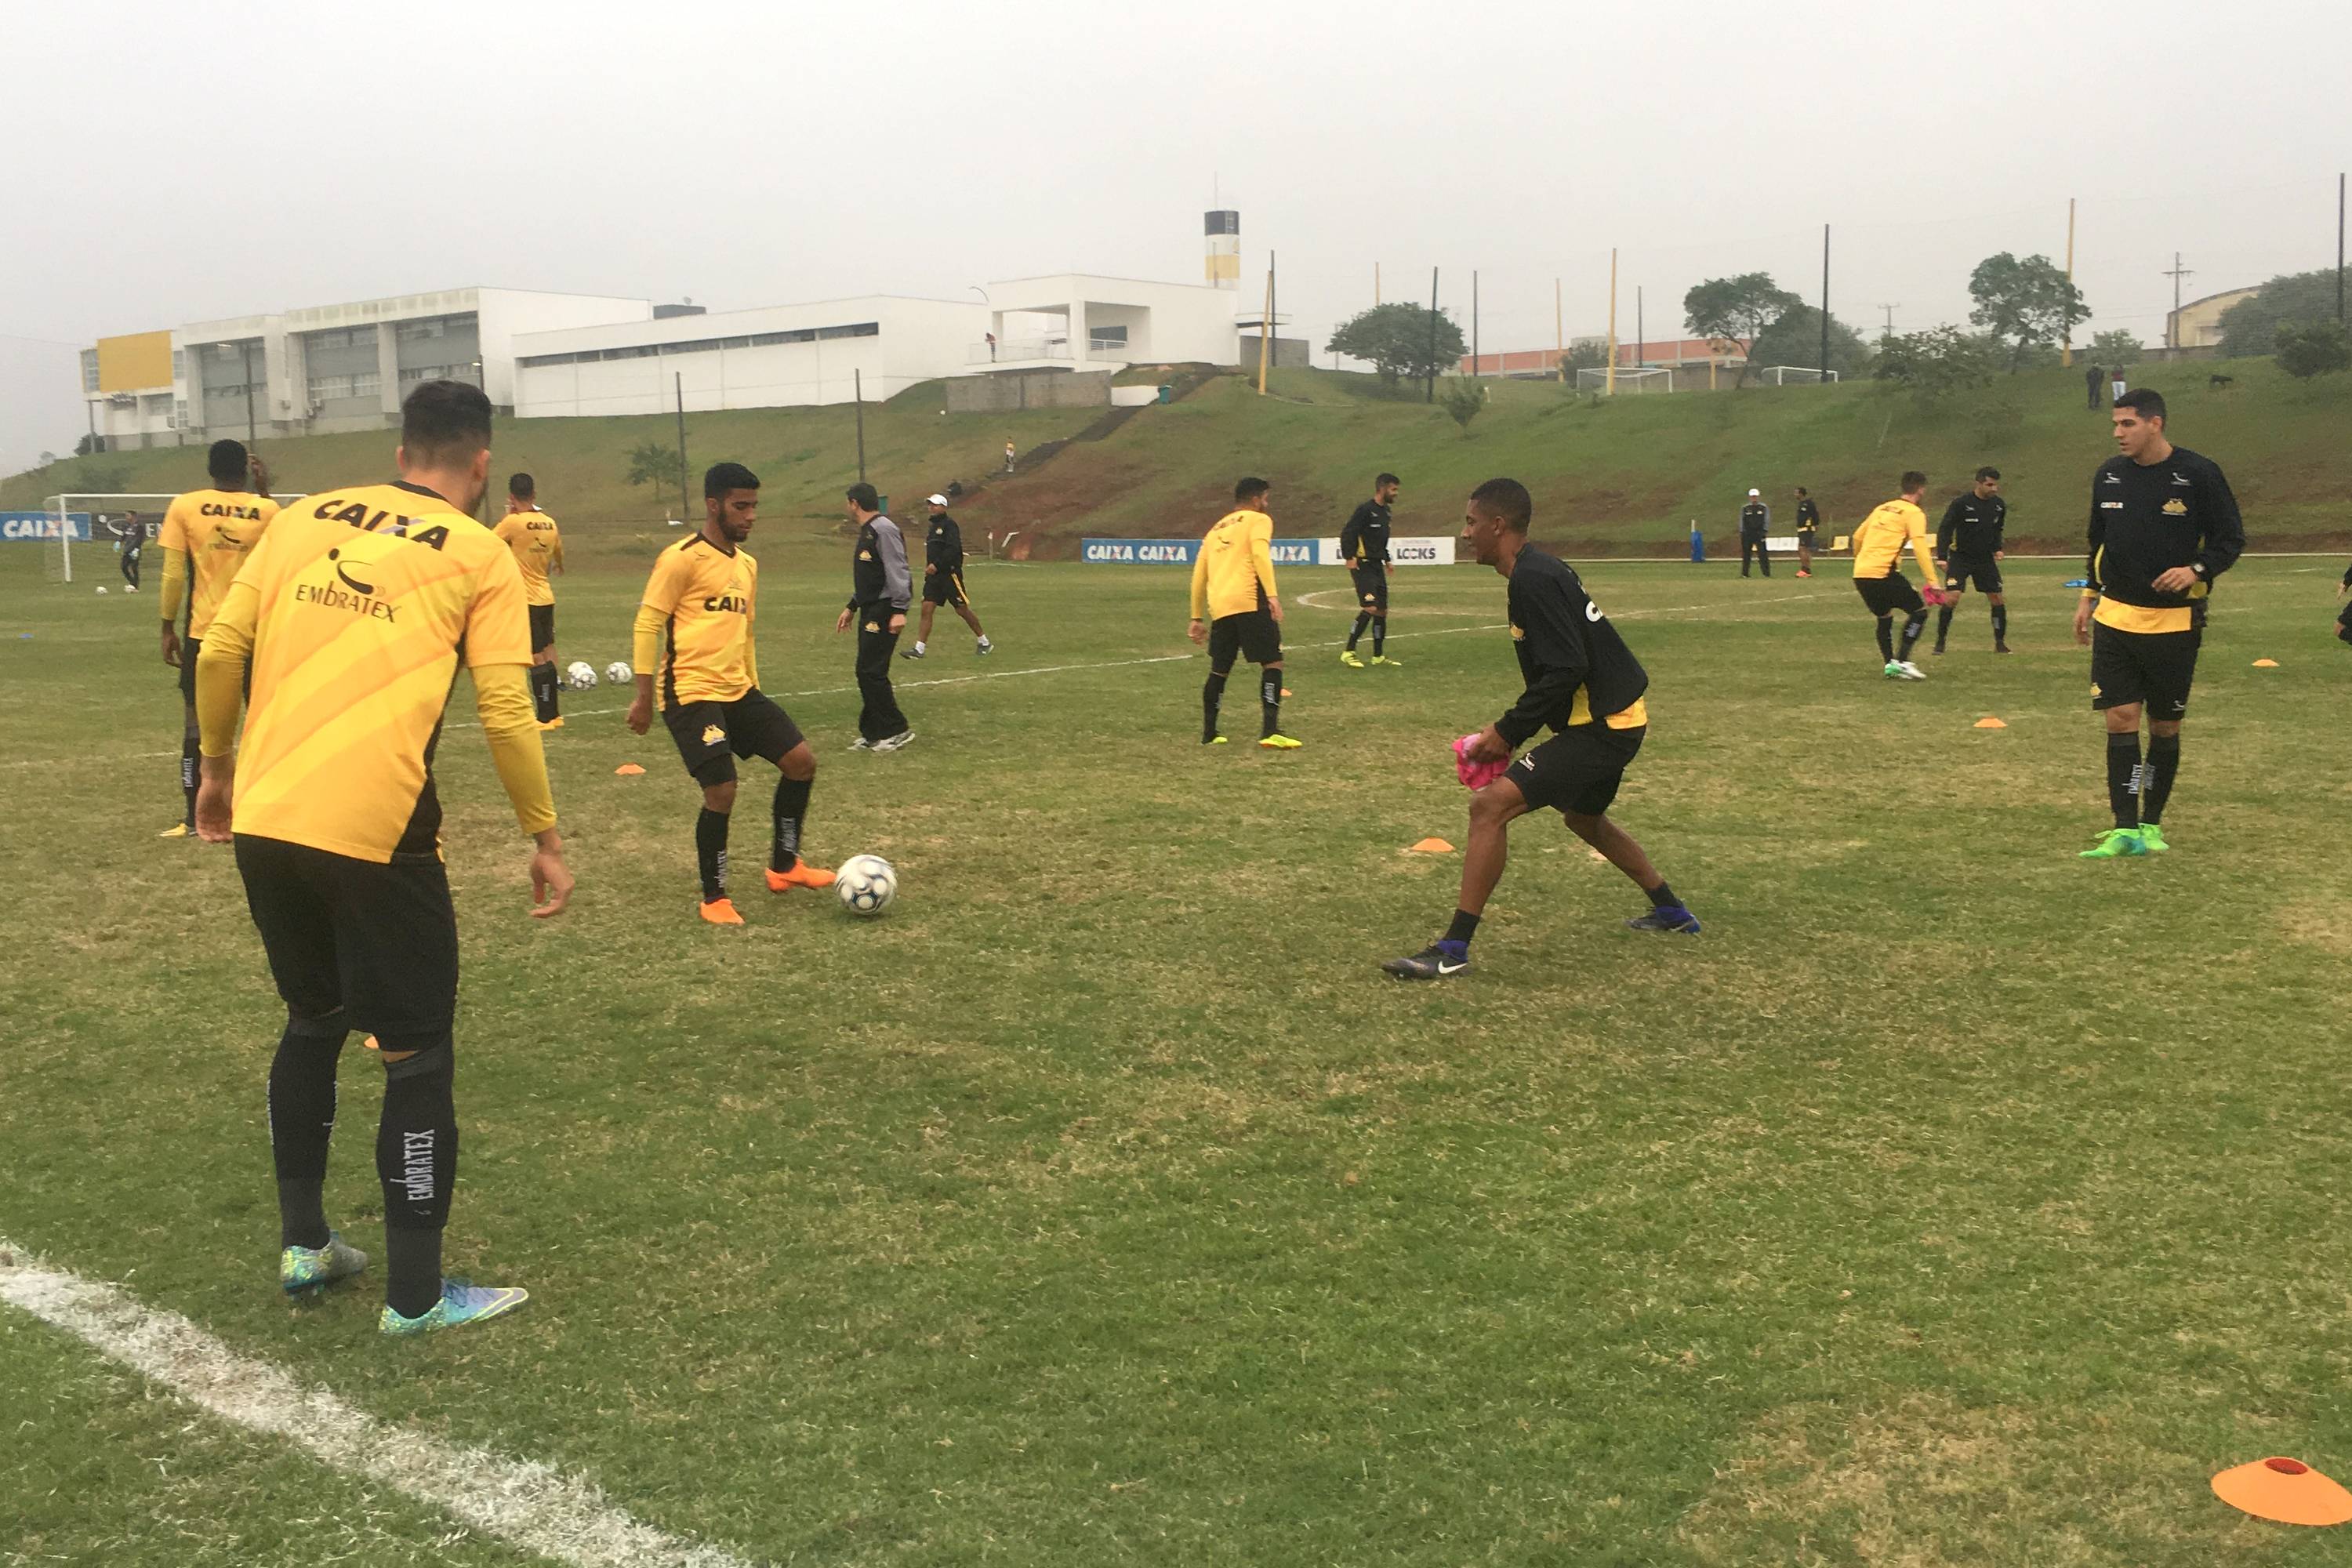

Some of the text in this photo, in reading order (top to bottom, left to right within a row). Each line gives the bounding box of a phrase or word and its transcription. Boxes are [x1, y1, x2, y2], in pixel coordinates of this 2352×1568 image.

[201, 503, 261, 521] CAIXA
[3, 520, 79, 538] CAIXA
[314, 500, 450, 551] CAIXA
[1087, 545, 1310, 561] CAIXA CAIXA AIXA
[703, 596, 747, 615] CAIX
